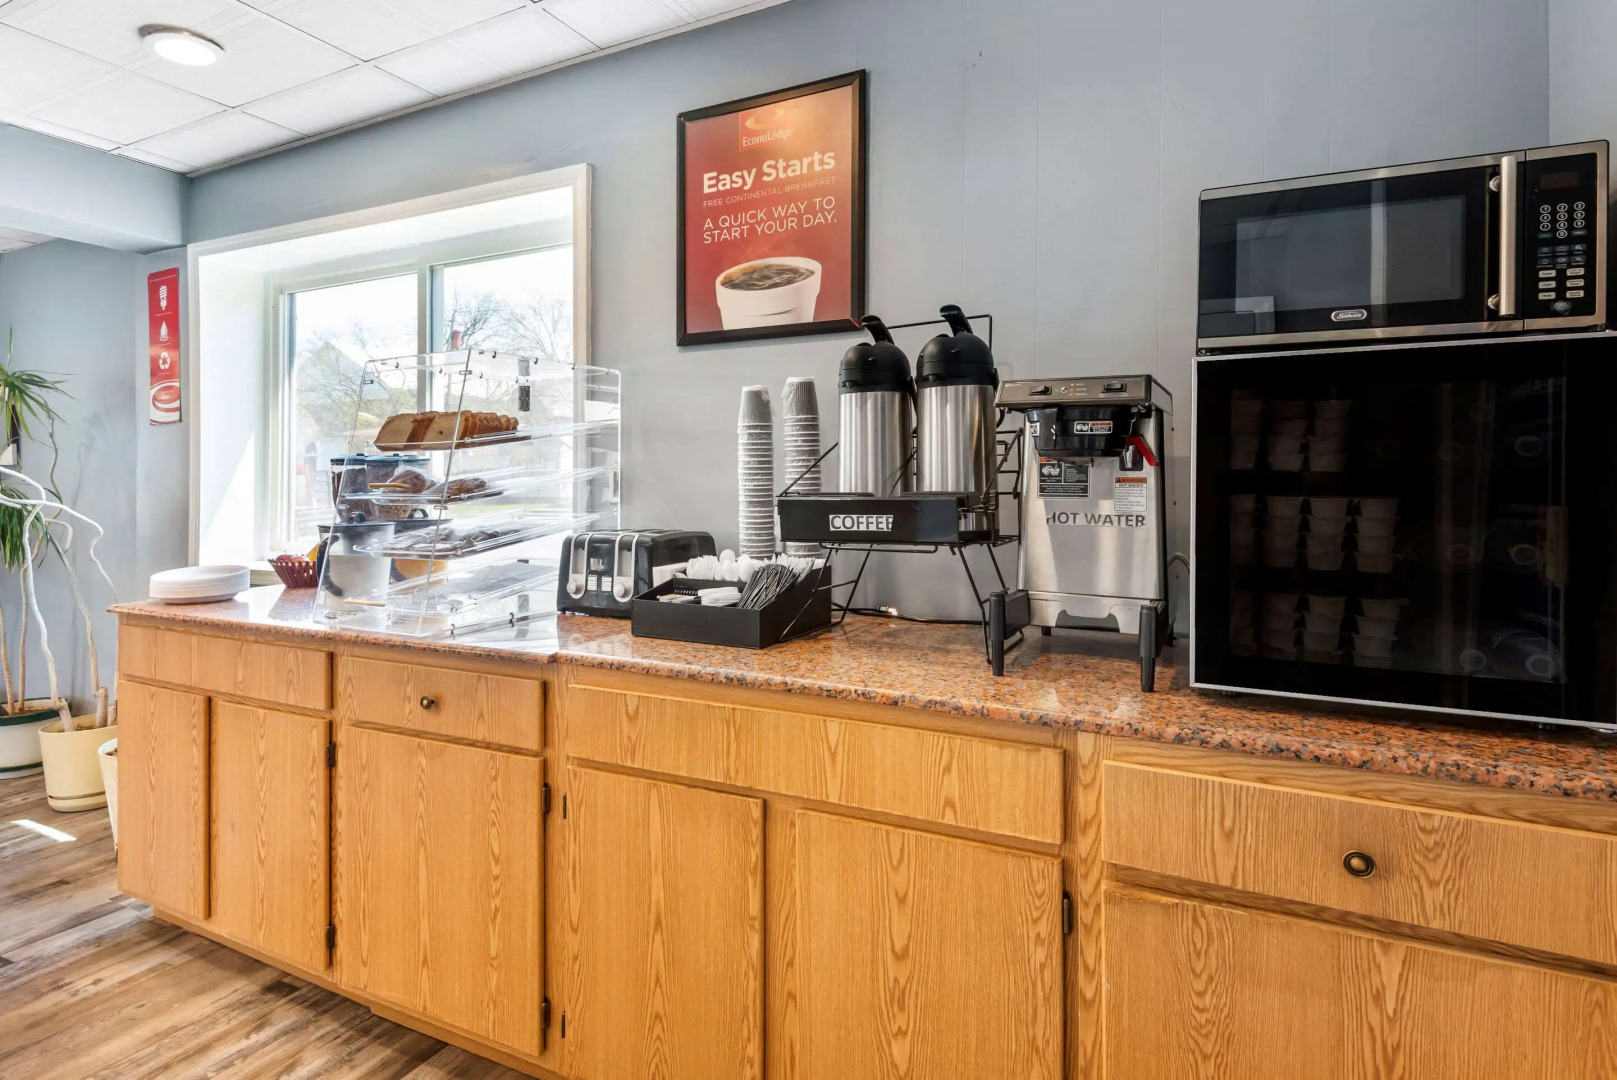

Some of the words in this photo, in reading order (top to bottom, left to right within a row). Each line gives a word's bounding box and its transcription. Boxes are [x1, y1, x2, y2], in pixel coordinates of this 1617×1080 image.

[703, 168, 757, 194] Easy
[762, 151, 836, 182] Starts
[703, 198, 723, 207] FREE
[725, 188, 782, 204] CONTINENTAL
[703, 218, 714, 231] A
[718, 208, 767, 229] QUICK
[772, 200, 808, 219] WAY
[813, 196, 836, 210] TO
[703, 225, 750, 244] START
[755, 217, 798, 236] YOUR
[803, 210, 837, 228] DAY.
[830, 515, 892, 530] COFFEE
[1046, 512, 1079, 524] HOT
[1084, 513, 1146, 527] WATER
